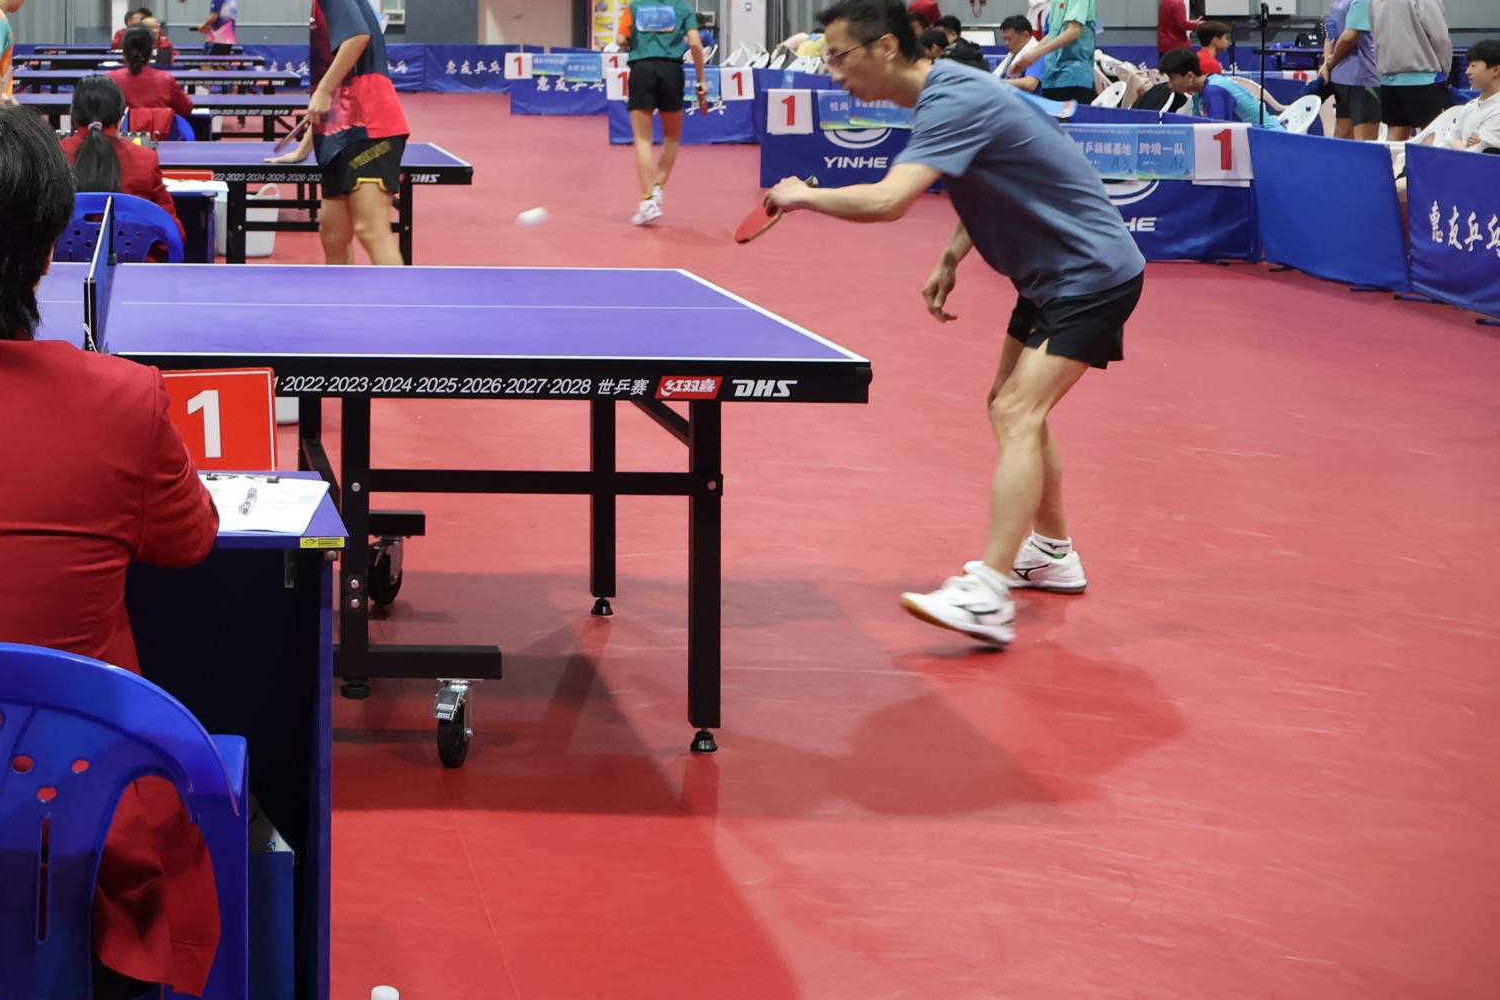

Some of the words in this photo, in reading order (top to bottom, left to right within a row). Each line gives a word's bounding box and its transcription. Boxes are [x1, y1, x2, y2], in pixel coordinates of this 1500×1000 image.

[513, 56, 523, 76] 1
[731, 71, 743, 97] 1
[781, 95, 796, 126] 1
[1213, 128, 1232, 171] 1
[823, 156, 889, 169] YINHE
[410, 173, 441, 183] DHS
[597, 377, 650, 396] 世乒赛
[731, 379, 798, 398] DHS
[186, 388, 222, 459] 1
